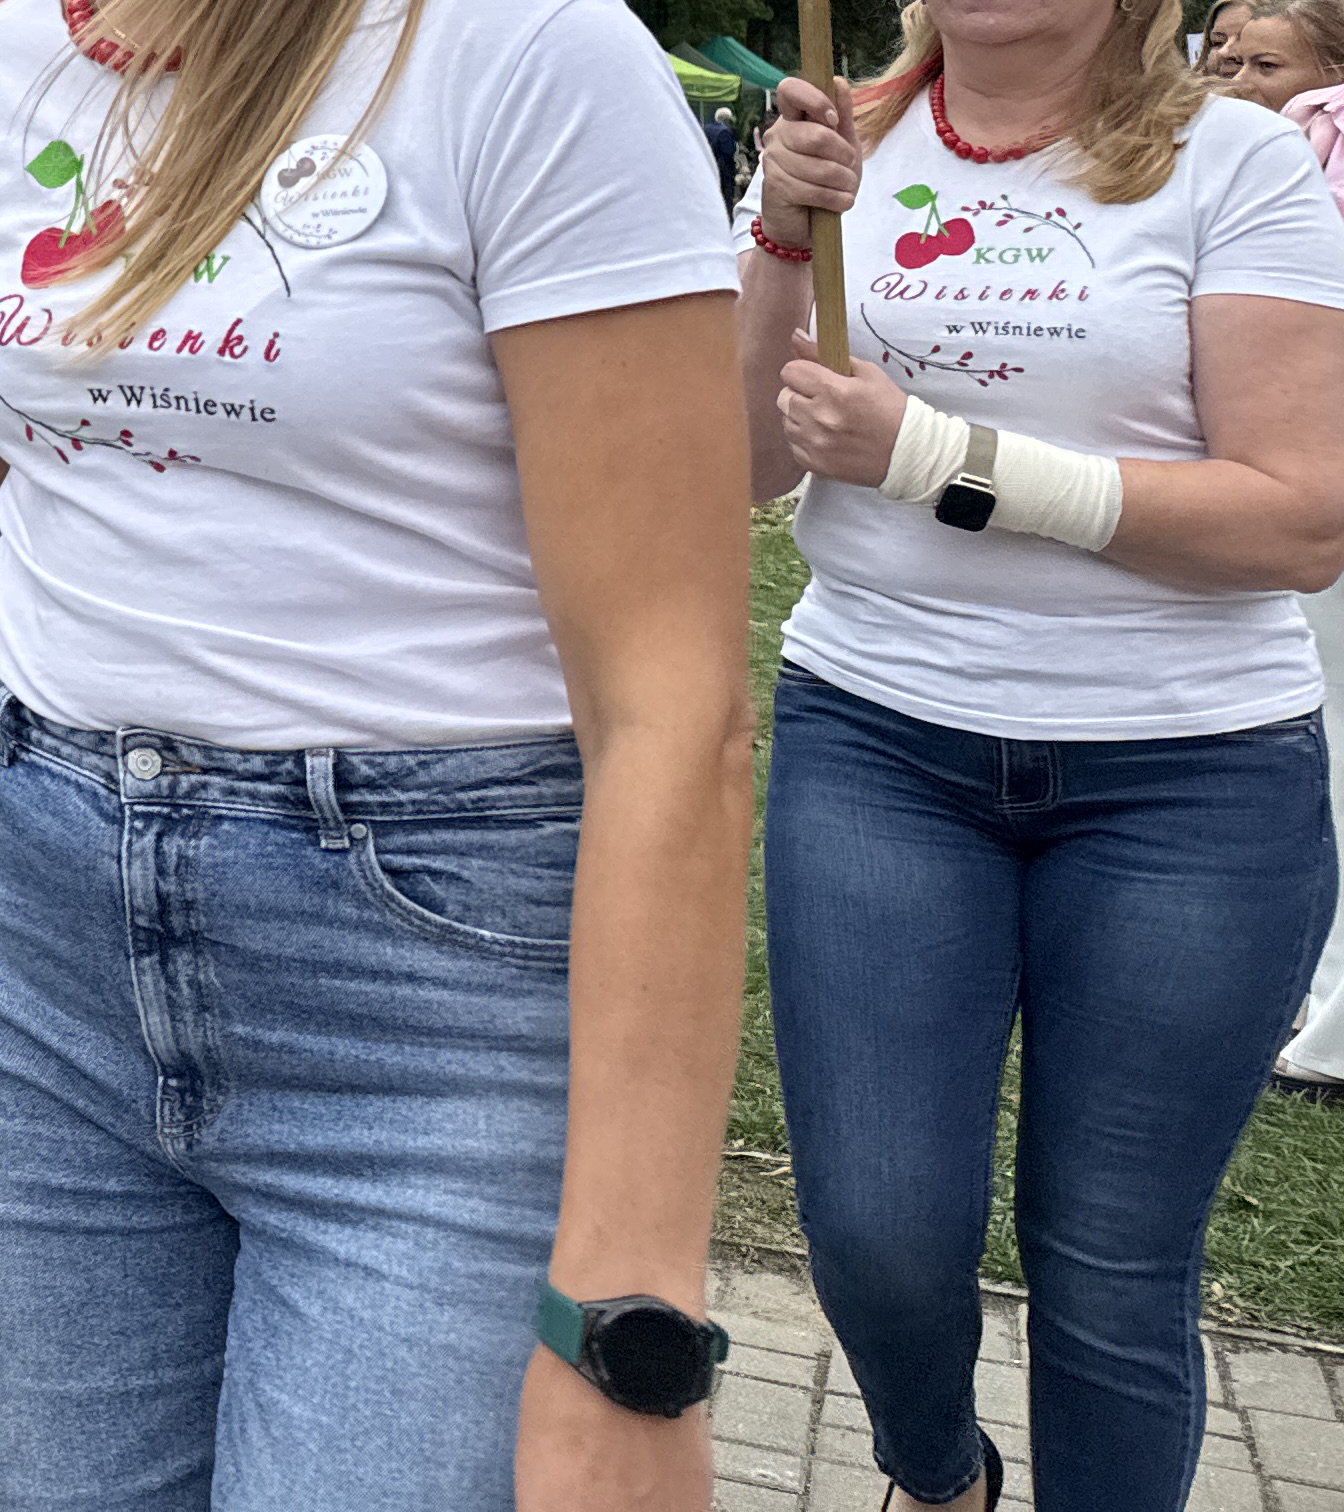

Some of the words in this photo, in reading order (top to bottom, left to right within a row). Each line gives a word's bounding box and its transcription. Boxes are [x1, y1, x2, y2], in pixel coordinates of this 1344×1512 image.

[972, 246, 1055, 266] KGW
[870, 271, 1090, 302] Wisienki
[945, 323, 965, 335] w
[969, 320, 1088, 339] Wiśniewie
[87, 387, 113, 405] w
[116, 384, 278, 423] Wiśniewie
